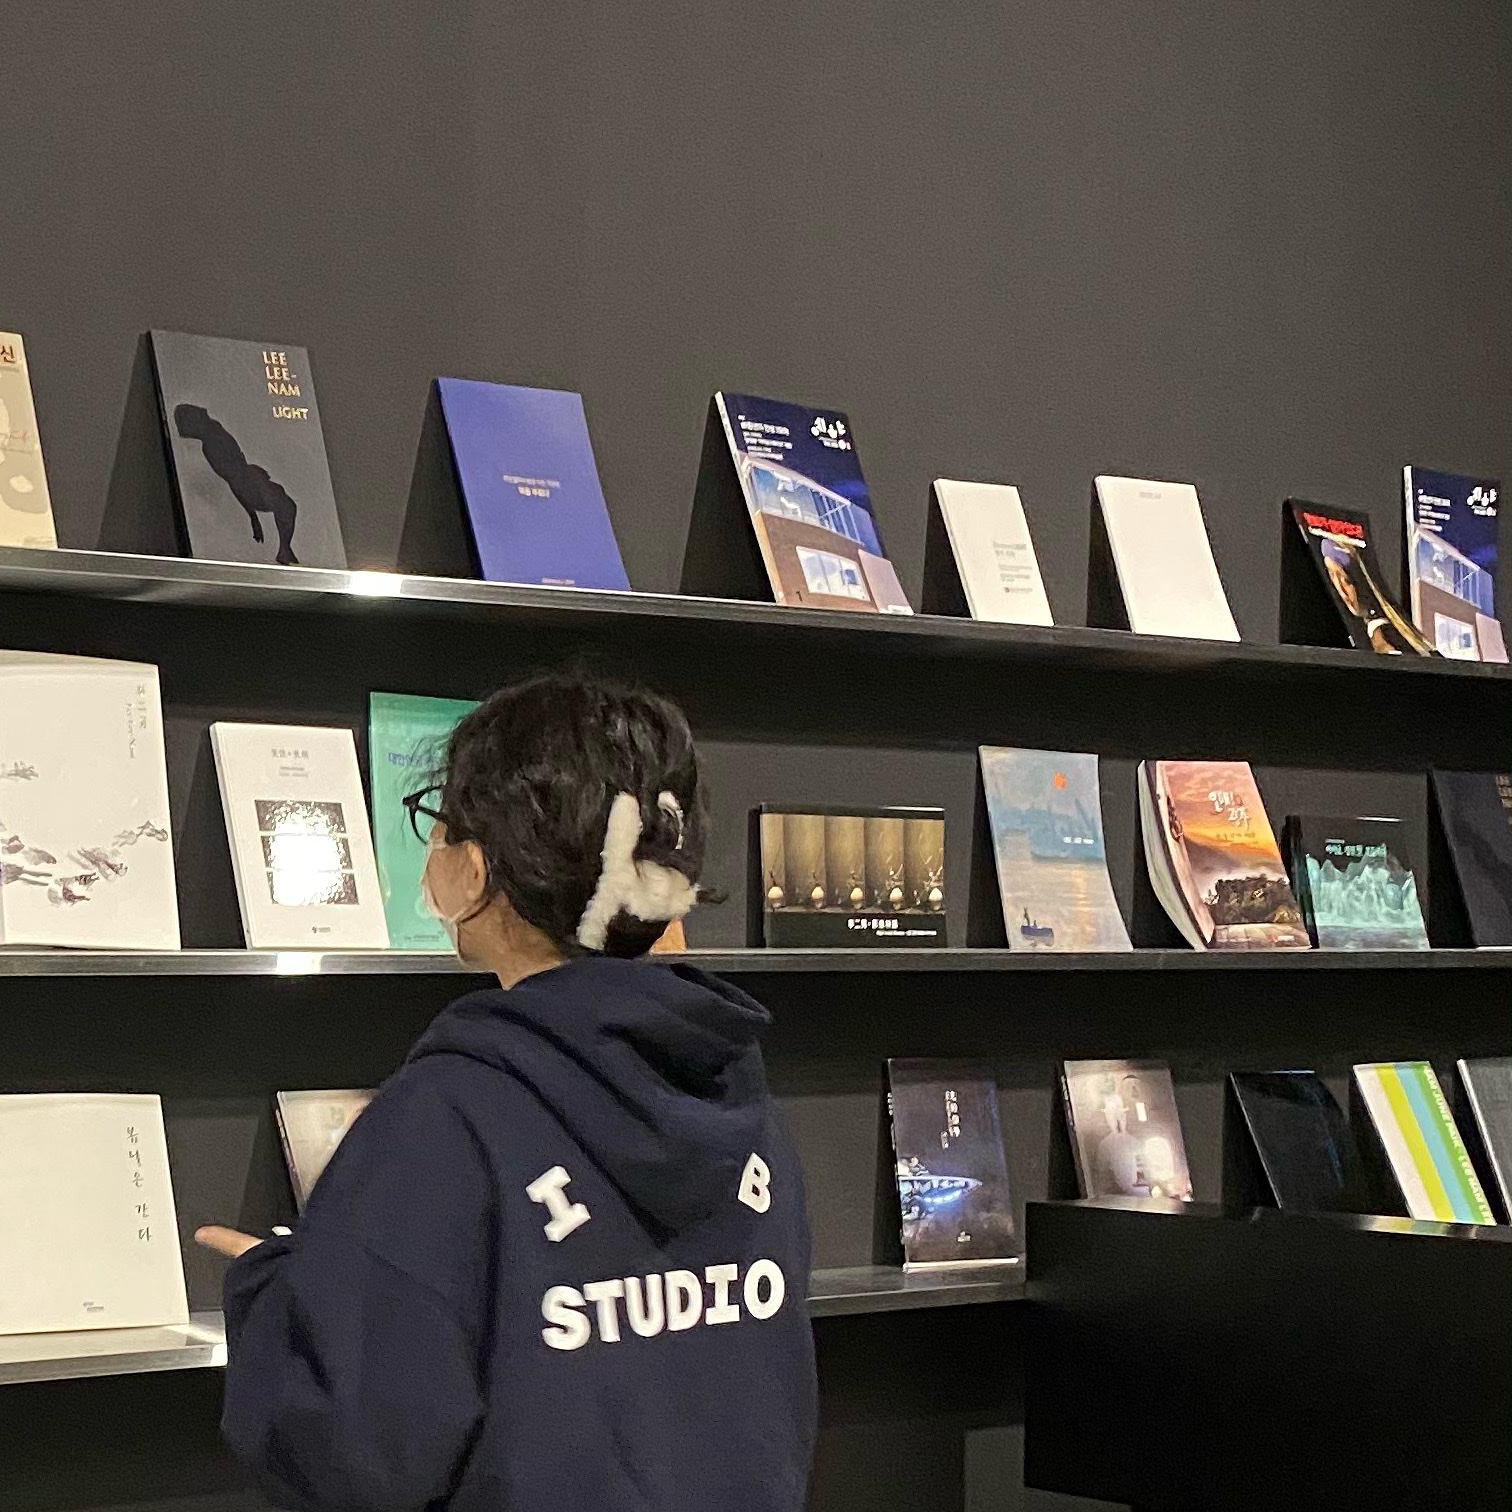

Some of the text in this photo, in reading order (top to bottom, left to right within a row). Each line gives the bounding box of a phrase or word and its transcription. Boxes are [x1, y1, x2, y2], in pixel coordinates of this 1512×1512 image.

[262, 351, 287, 365] LEE
[266, 366, 296, 380] LEE-
[268, 382, 300, 396] NAM
[272, 406, 308, 420] LIGHT
[1432, 1090, 1451, 1122] JUNE
[1445, 1121, 1461, 1149] PAIK
[1468, 1177, 1485, 1203] NAM
[541, 1258, 786, 1352] STUDIO
